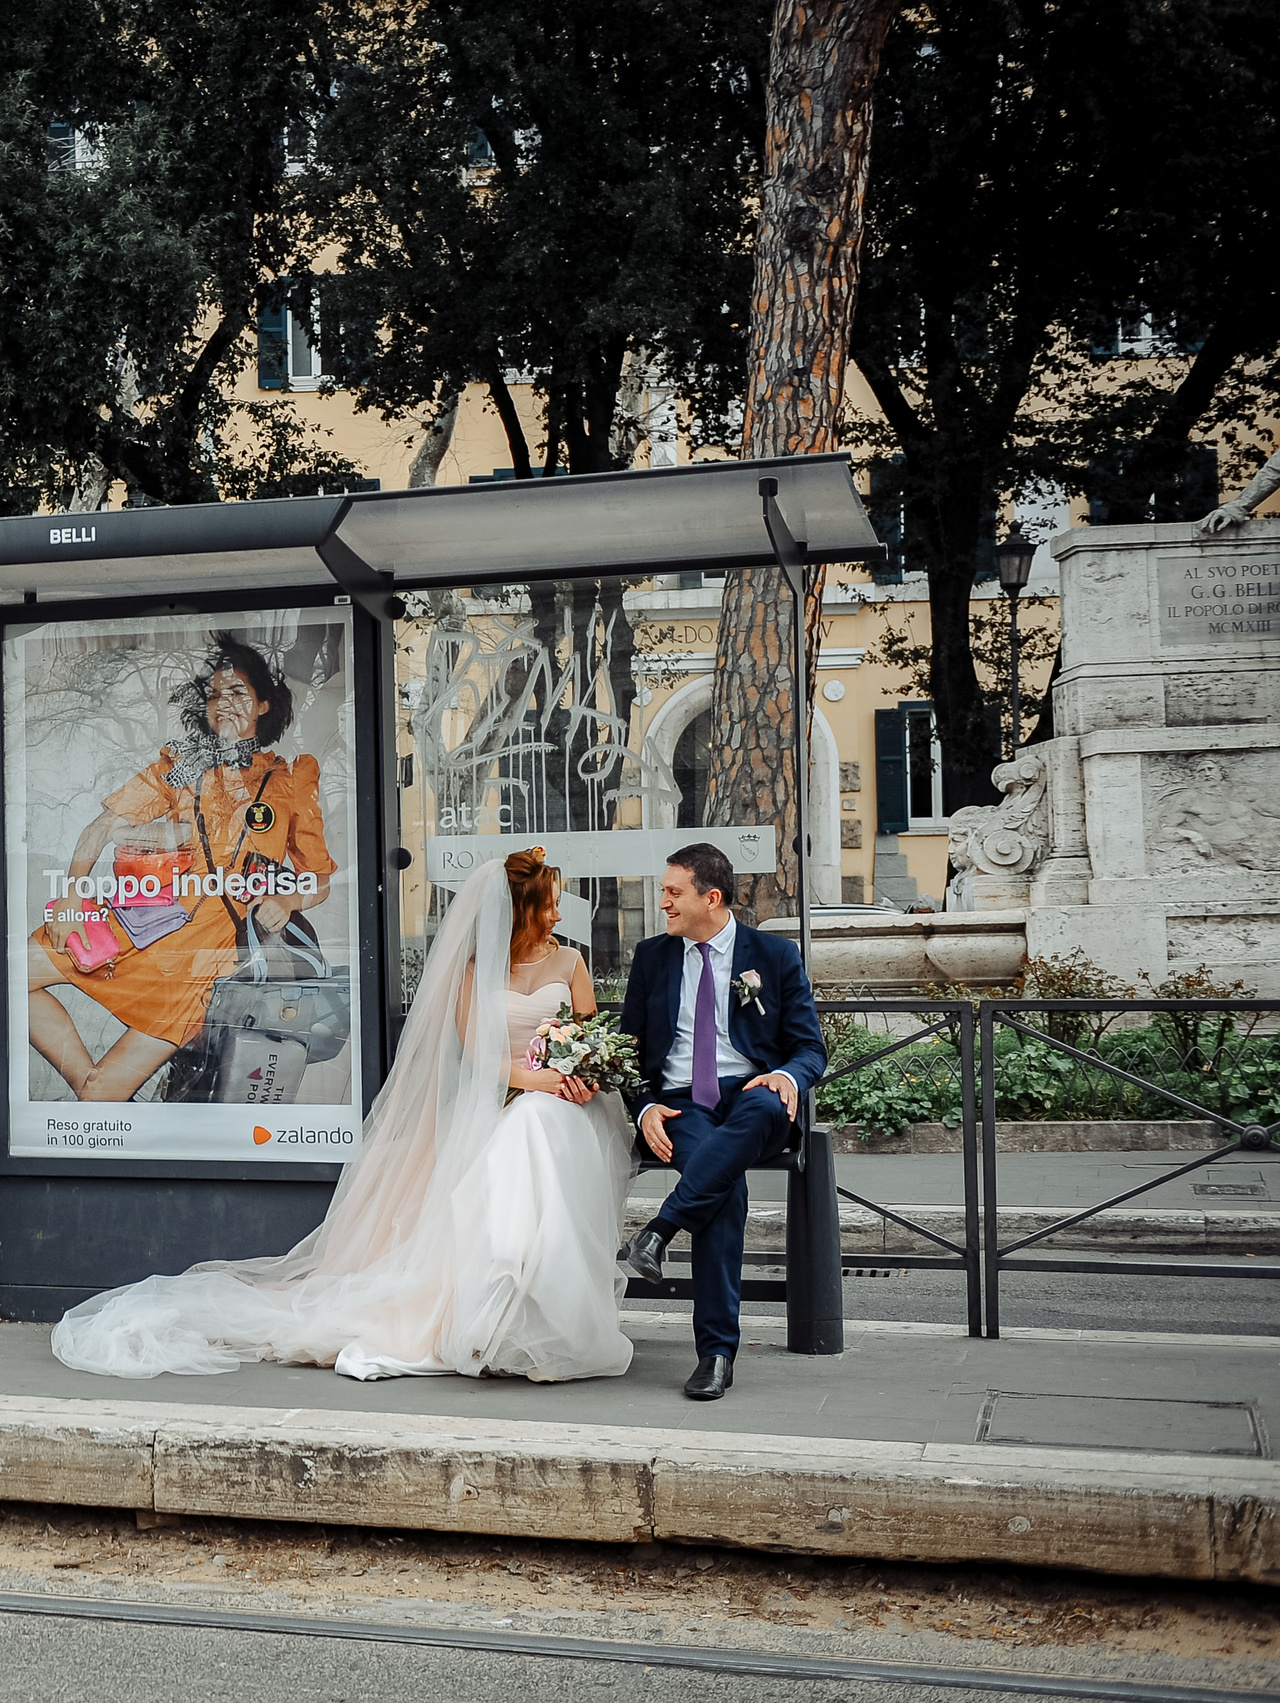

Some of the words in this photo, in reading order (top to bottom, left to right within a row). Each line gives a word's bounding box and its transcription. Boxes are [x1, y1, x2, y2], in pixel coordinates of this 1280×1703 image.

[50, 527, 96, 545] BELLI
[1184, 567, 1203, 579] AL
[1207, 566, 1237, 578] SVO
[1241, 563, 1280, 577] POET
[1235, 581, 1280, 598] BELL
[1167, 606, 1181, 618] IL
[1184, 603, 1244, 617] POPOLO
[1248, 602, 1263, 615] DI
[1208, 620, 1272, 634] MCMXIII
[440, 801, 512, 829] atac
[43, 869, 161, 906] Troppo
[172, 866, 318, 897] indecisa
[44, 909, 54, 922] E
[57, 908, 109, 922] allora?
[47, 1119, 79, 1131] Reso
[83, 1120, 132, 1134] gratuito
[47, 1134, 58, 1145] in
[62, 1134, 84, 1146] 100
[88, 1135, 124, 1149] giorni
[277, 1126, 354, 1144] zalando
